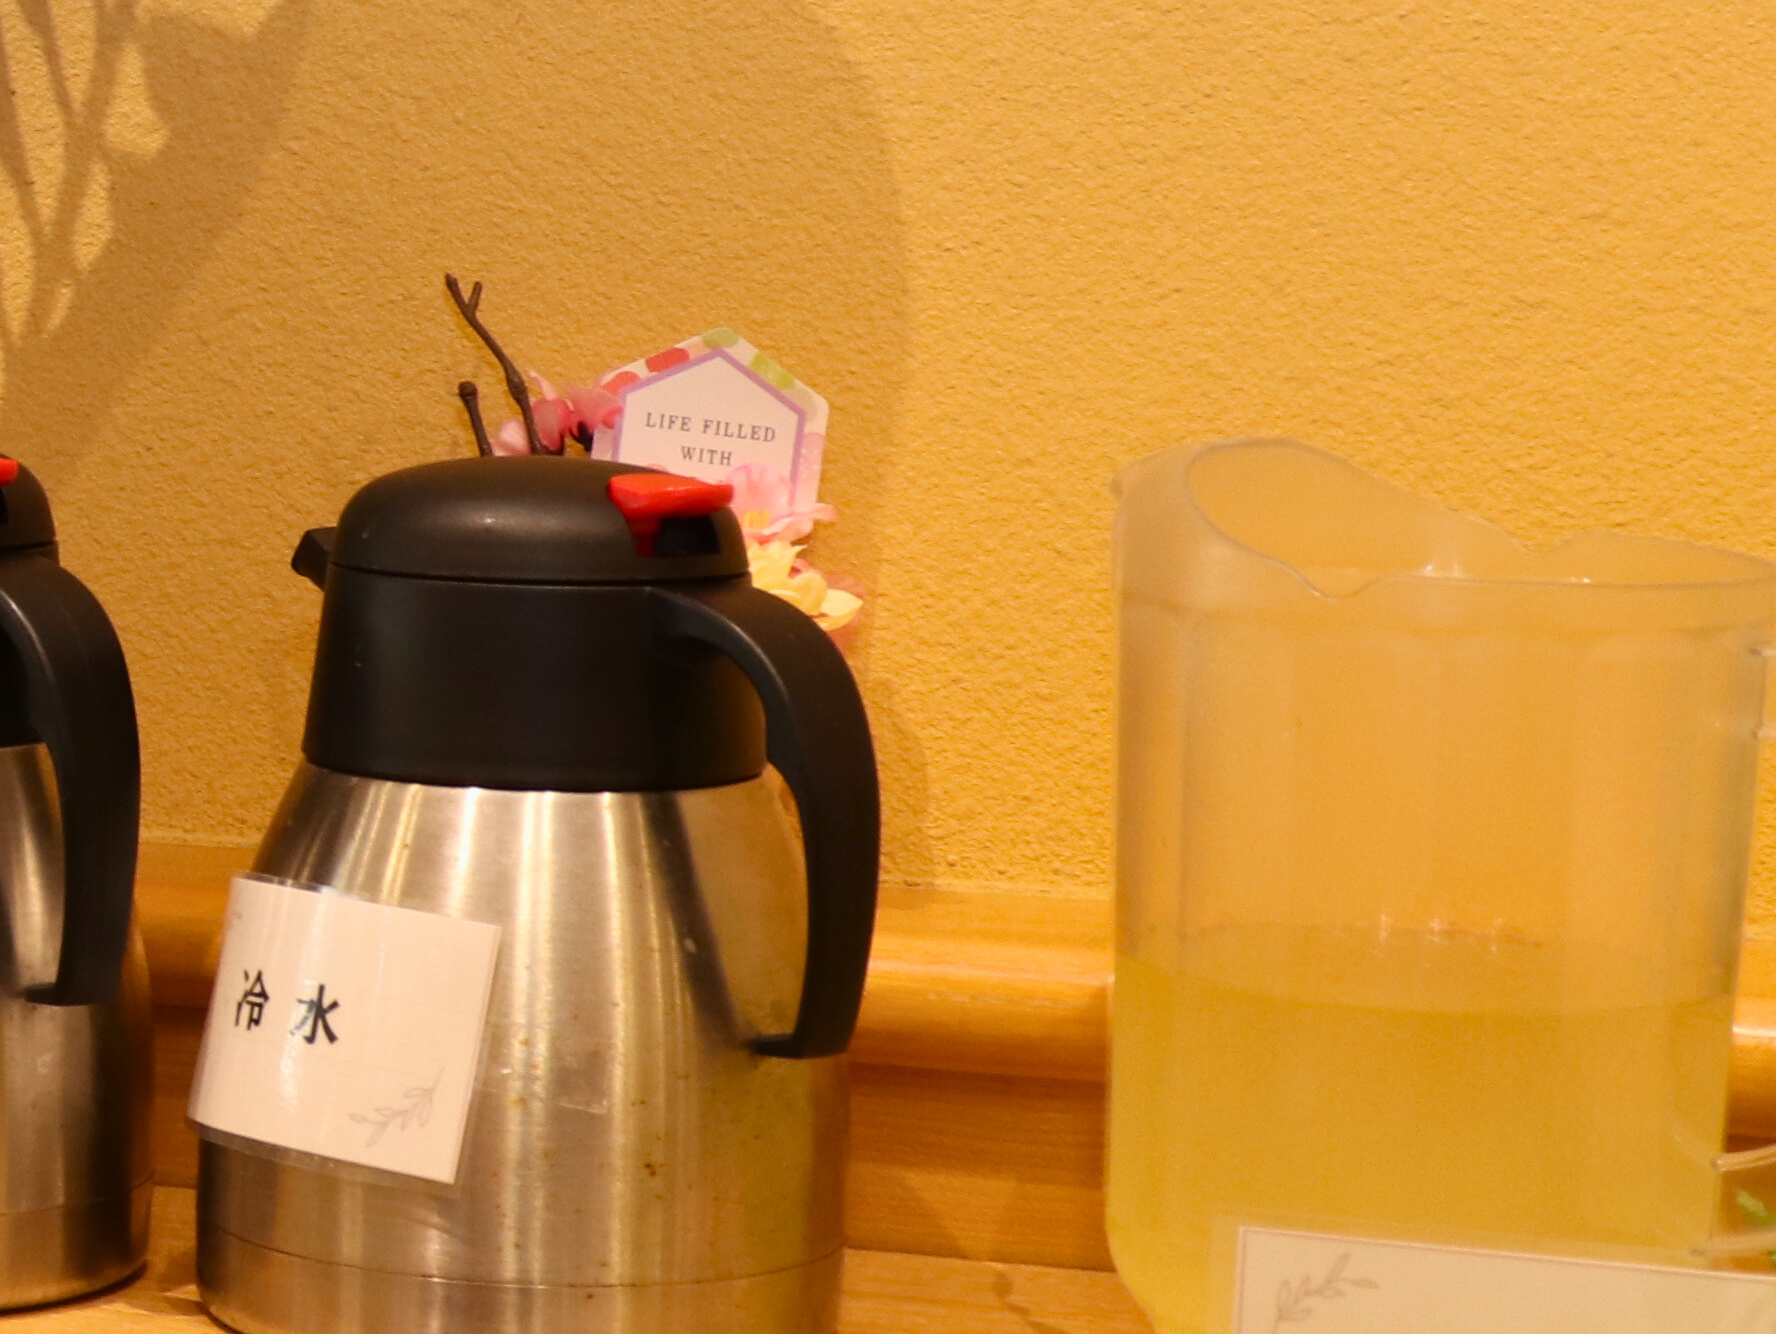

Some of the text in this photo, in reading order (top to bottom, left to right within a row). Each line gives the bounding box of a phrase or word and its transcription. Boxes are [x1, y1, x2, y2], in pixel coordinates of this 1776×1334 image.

[645, 412, 776, 442] LIFE FILLED
[680, 446, 732, 466] WITH
[235, 969, 340, 1045] 冷水
